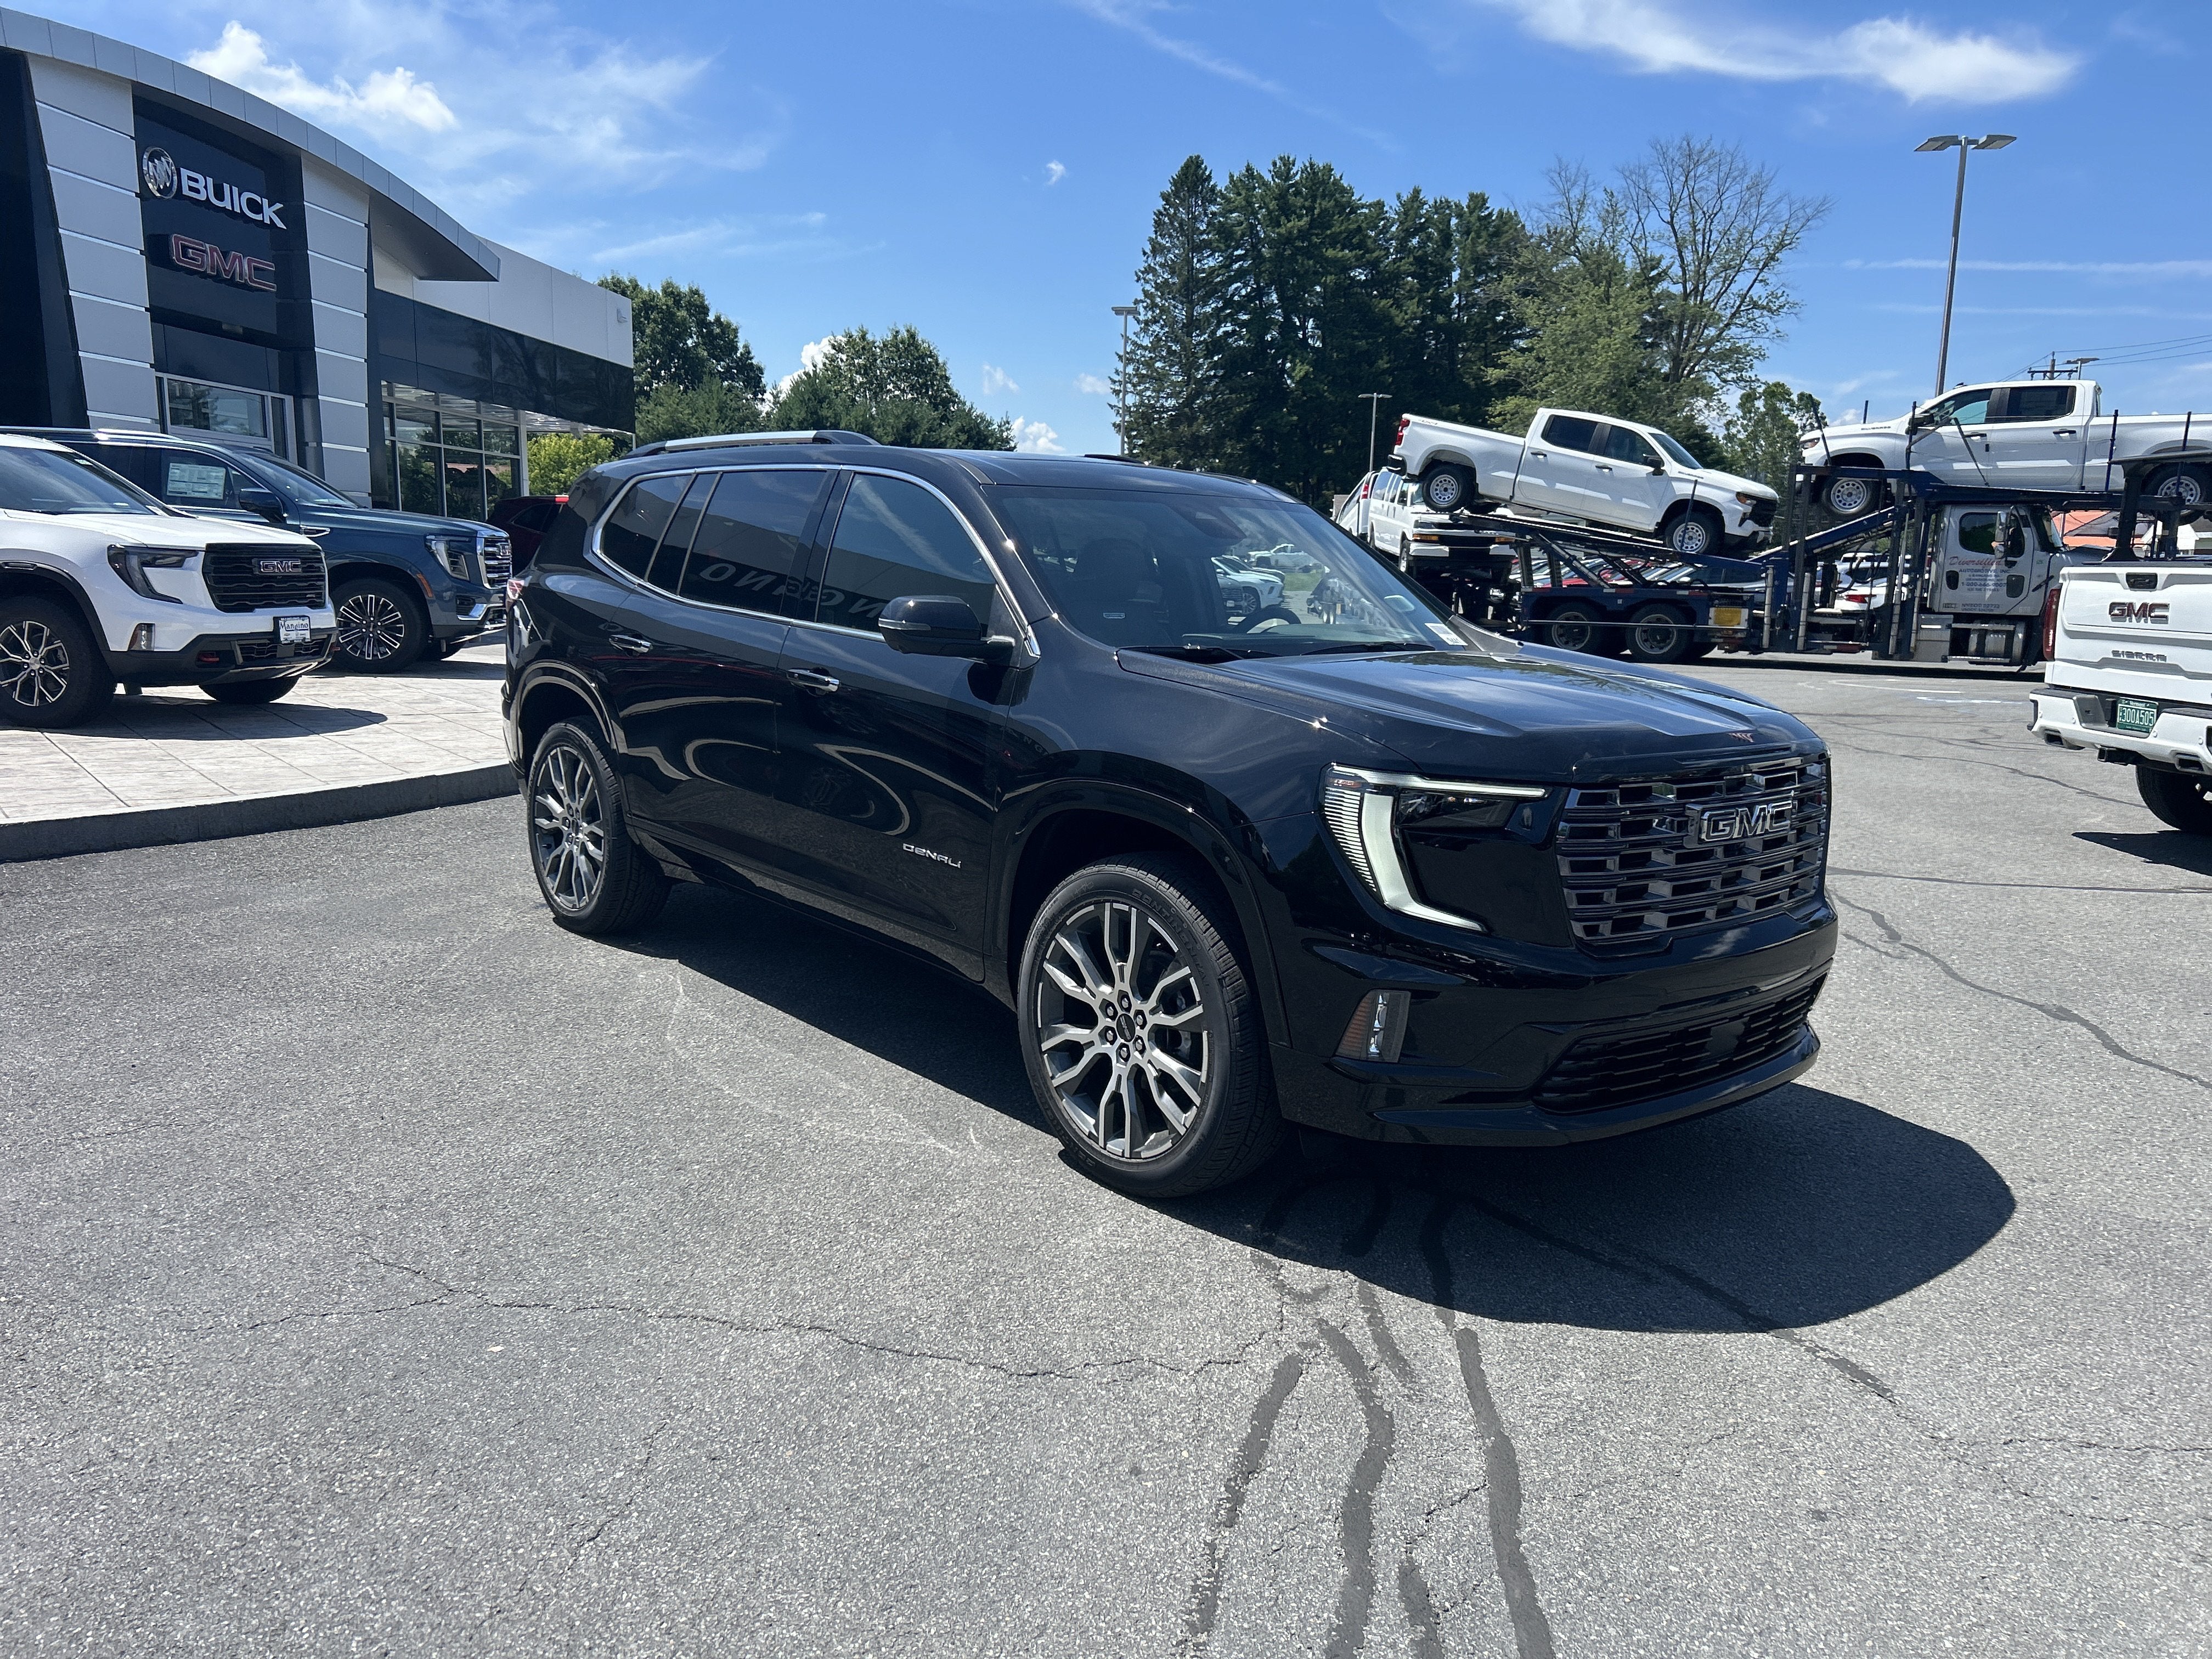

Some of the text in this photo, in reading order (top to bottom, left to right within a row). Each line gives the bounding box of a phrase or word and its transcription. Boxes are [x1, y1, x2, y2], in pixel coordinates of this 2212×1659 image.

[179, 167, 287, 230] BUICK
[172, 234, 277, 292] GMC
[259, 561, 302, 573] GMC
[2108, 601, 2170, 620] GMC
[2121, 707, 2154, 726] 300A505
[1701, 800, 1792, 842] GMC
[902, 843, 962, 868] DENALI
